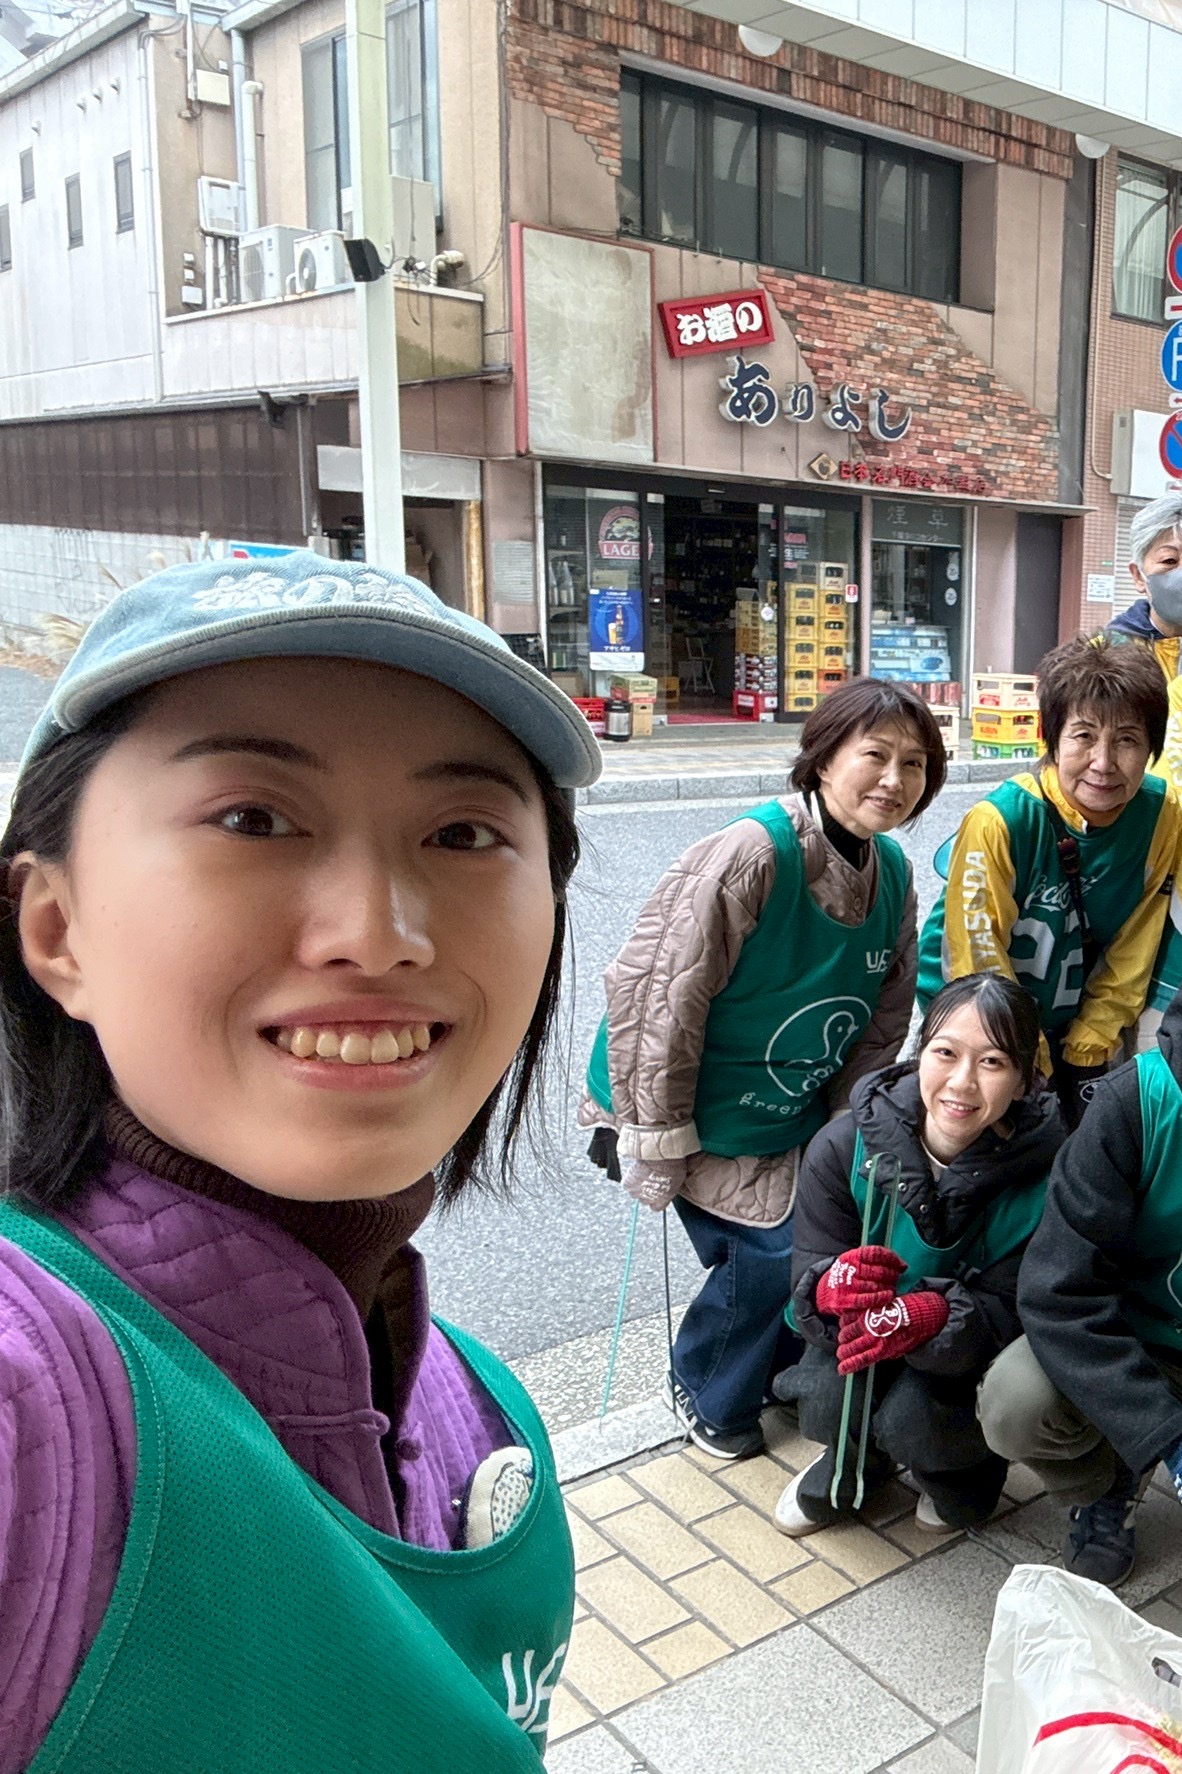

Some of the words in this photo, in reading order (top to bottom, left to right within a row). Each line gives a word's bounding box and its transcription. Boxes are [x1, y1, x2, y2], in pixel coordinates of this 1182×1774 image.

[676, 301, 763, 345] お酒の
[722, 355, 912, 442] ありよし
[603, 543, 640, 556] LAGE
[962, 851, 998, 959] YASUDA
